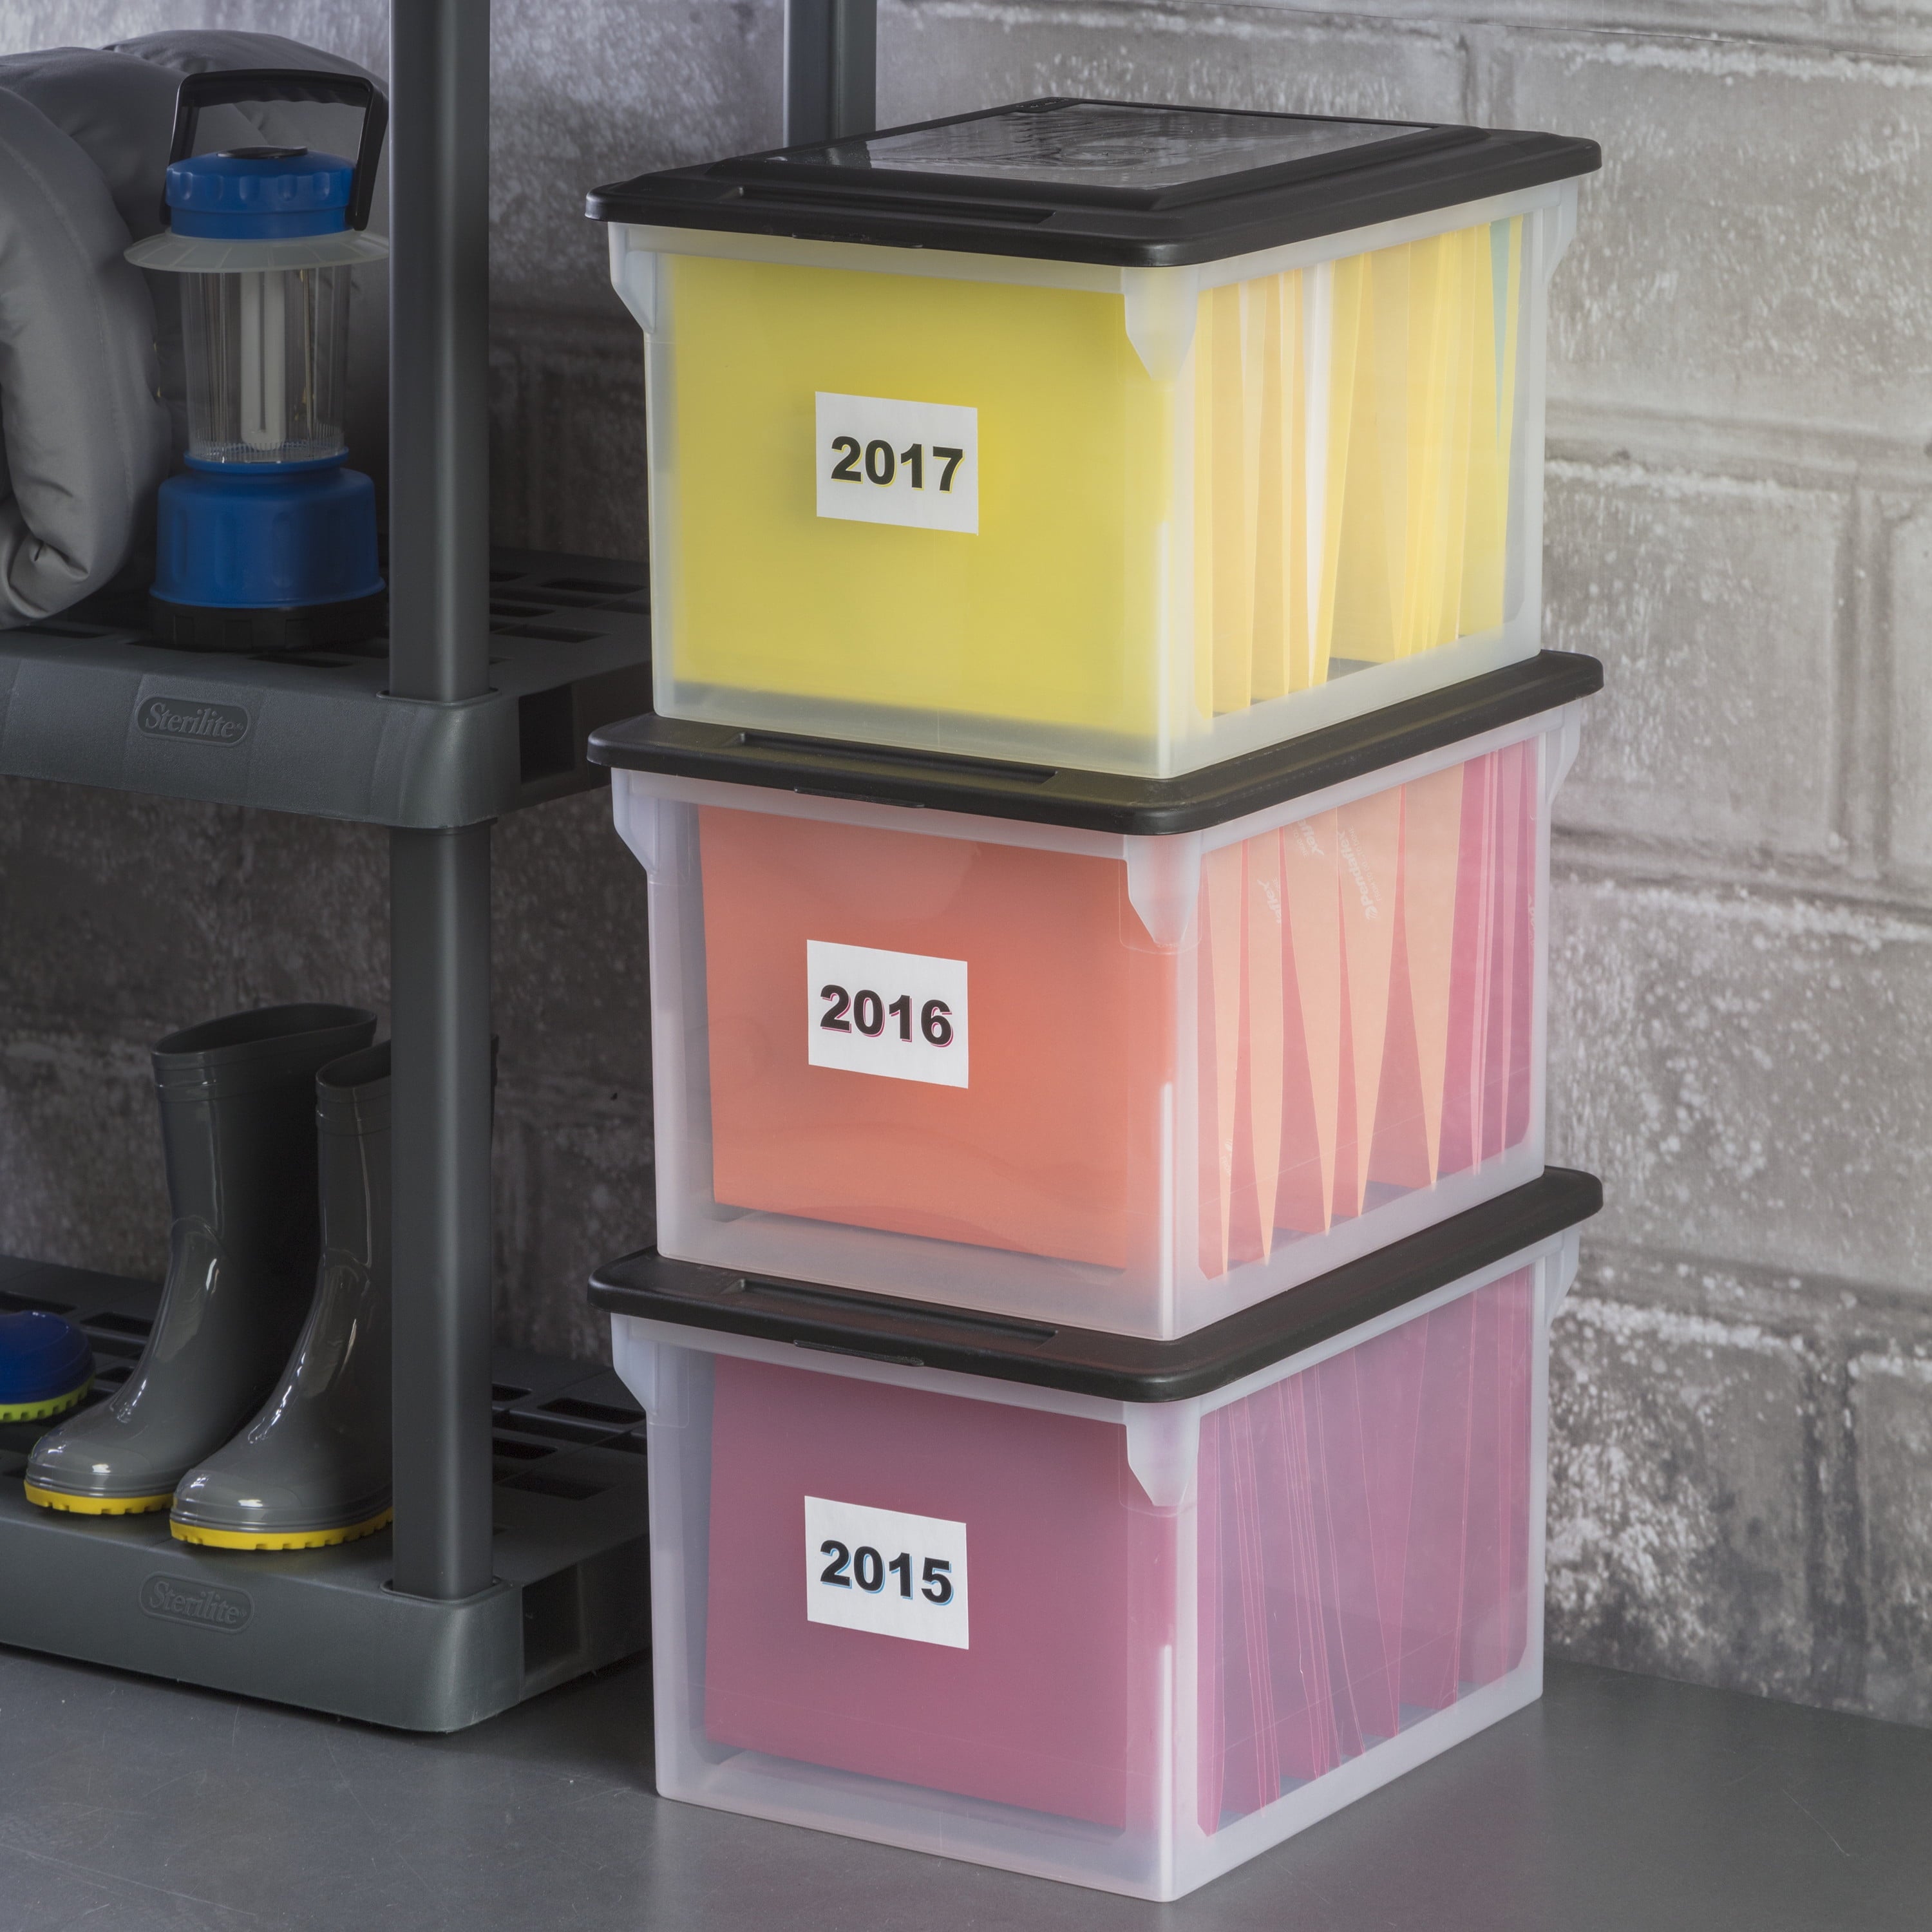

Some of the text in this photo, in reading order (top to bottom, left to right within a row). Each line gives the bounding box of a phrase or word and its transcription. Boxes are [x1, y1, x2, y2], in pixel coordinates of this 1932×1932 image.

[831, 436, 965, 494] 2017
[145, 702, 234, 739] Sterilite
[1338, 830, 1374, 907] Pendaflex
[820, 984, 953, 1048] 2016
[820, 1540, 953, 1606] 2015
